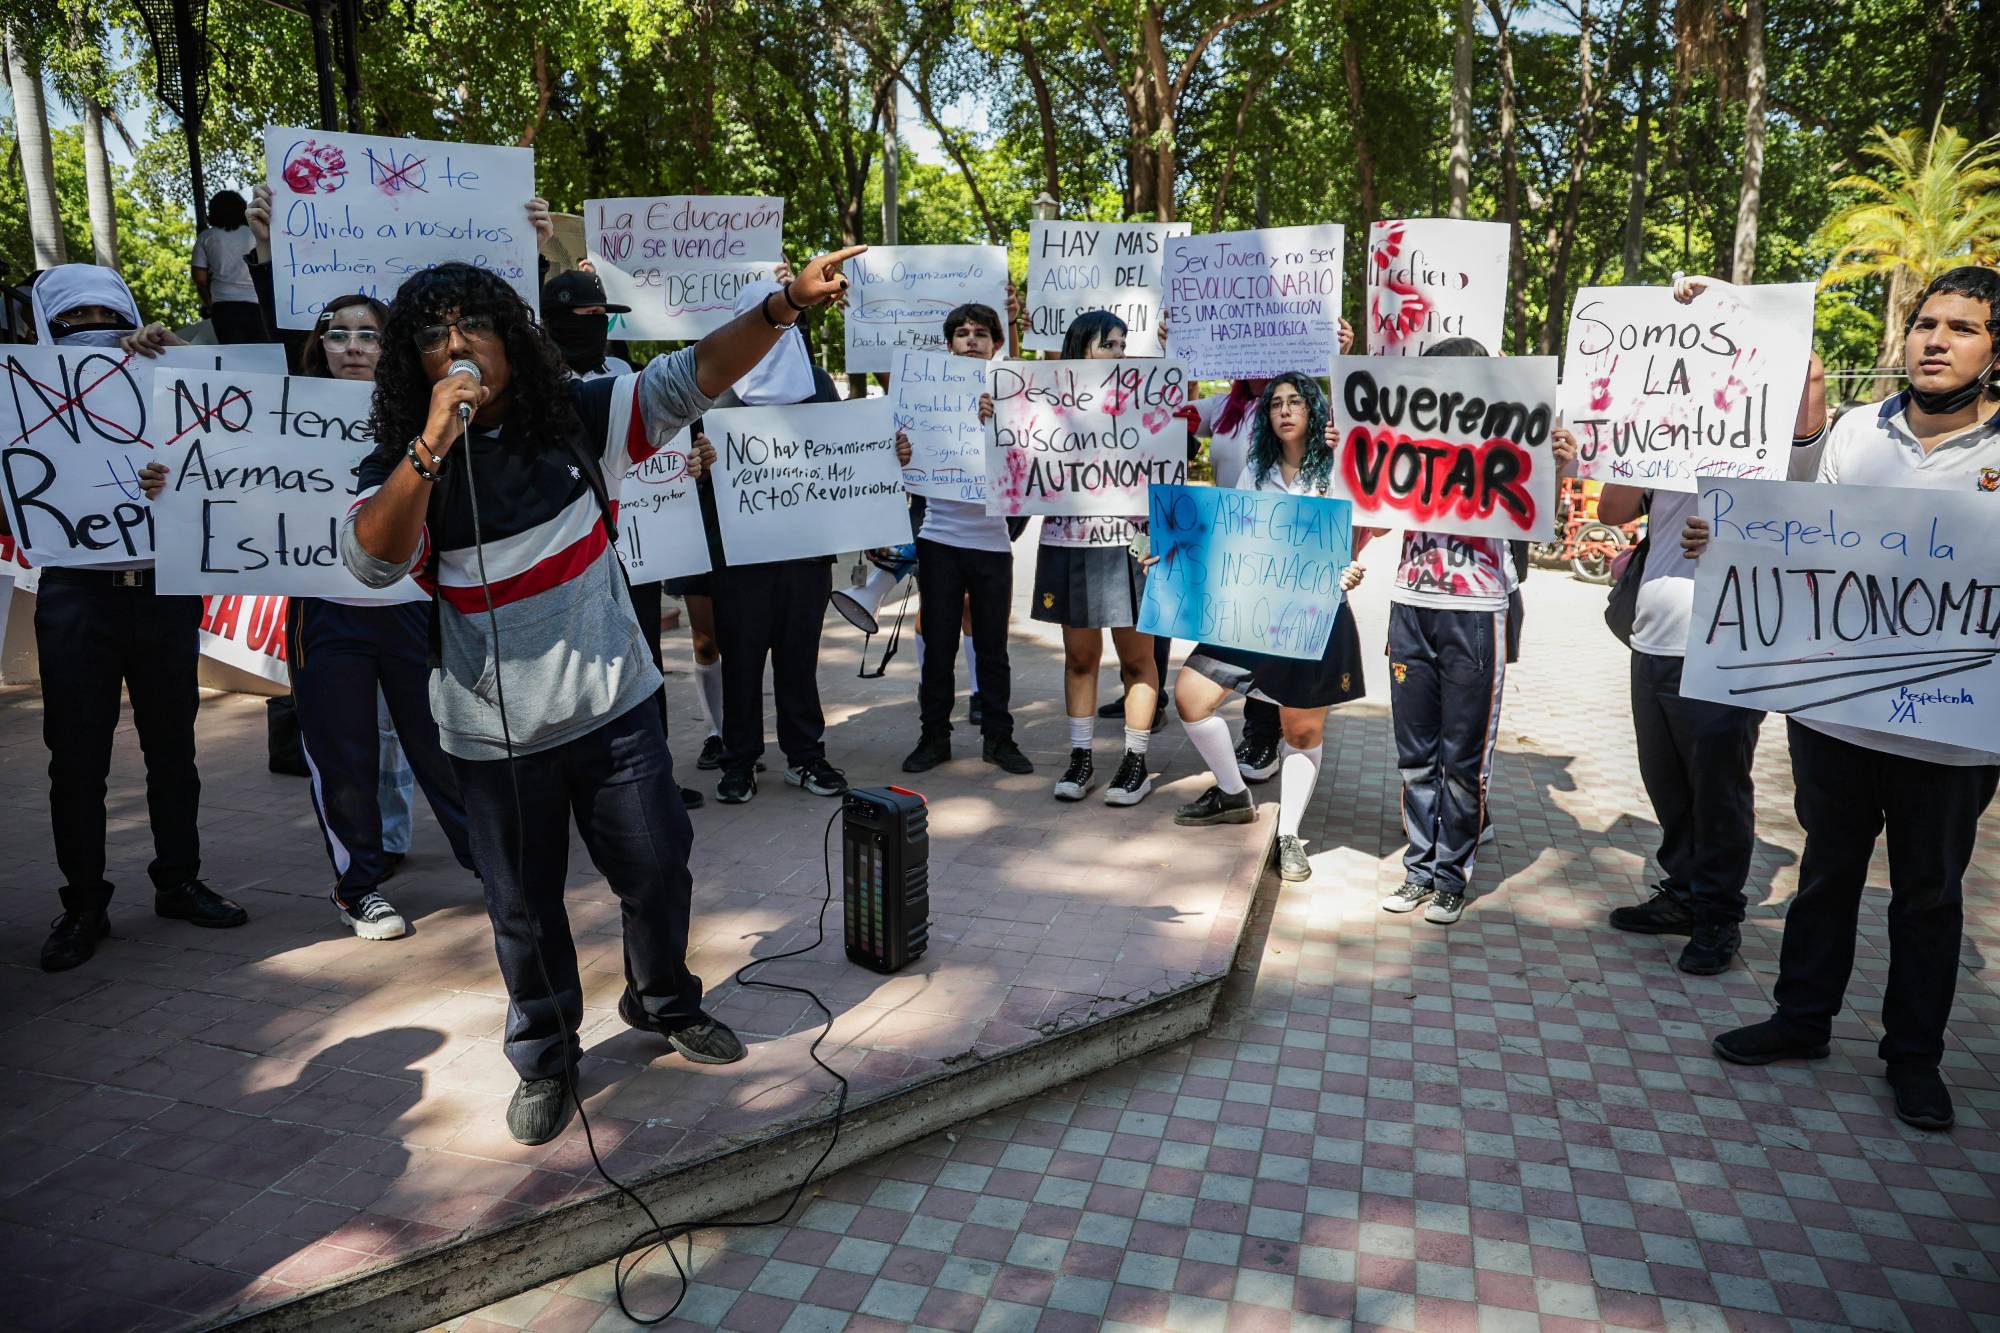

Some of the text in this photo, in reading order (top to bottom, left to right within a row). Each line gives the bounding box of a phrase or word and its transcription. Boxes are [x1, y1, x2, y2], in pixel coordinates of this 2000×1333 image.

[364, 147, 427, 191] NO
[438, 157, 481, 190] te
[286, 199, 513, 244] Olvido a nosotros
[599, 200, 781, 232] La Educación
[602, 231, 747, 261] NO se vende
[1042, 226, 1159, 259] HAY MÁS
[1175, 246, 1209, 274] Ser
[1214, 242, 1266, 270] Joven
[1269, 255, 1280, 268] y
[1285, 252, 1304, 265] no
[632, 267, 663, 288] se
[851, 257, 885, 286] Nos
[1041, 264, 1100, 293] ACOSO
[1115, 264, 1149, 288] DEL
[1171, 268, 1334, 303] REVOLUCIONARIO
[1031, 305, 1067, 336] QUE
[1171, 305, 1192, 324] ES
[1196, 304, 1218, 322] UNA
[1576, 301, 1737, 356] Somos
[852, 327, 887, 348] basta
[893, 331, 907, 347] de
[1211, 322, 1251, 342] HASTA
[942, 360, 966, 383] bien
[990, 367, 1093, 411] Desde
[1099, 363, 1184, 412] 1968
[1643, 355, 1690, 396] LA
[6, 353, 147, 444] NO
[174, 378, 253, 435] NO
[914, 394, 961, 413] realidad
[1344, 370, 1551, 447] Queremo
[994, 412, 1140, 453] buscando
[175, 438, 335, 494] Armas
[643, 453, 681, 478] FALTE
[726, 432, 769, 471] NO
[773, 437, 799, 459] hay
[1611, 459, 1634, 478] NO
[1637, 458, 1690, 479] SOMOS
[1353, 435, 1527, 516] VOTAR
[1154, 493, 1198, 531] NO
[1211, 493, 1350, 552] ARREGLAN
[1703, 488, 1955, 561] Respeto a la
[1153, 539, 1208, 586] LAS
[1171, 592, 1186, 633] Y
[1900, 686, 1974, 706] Respetenla
